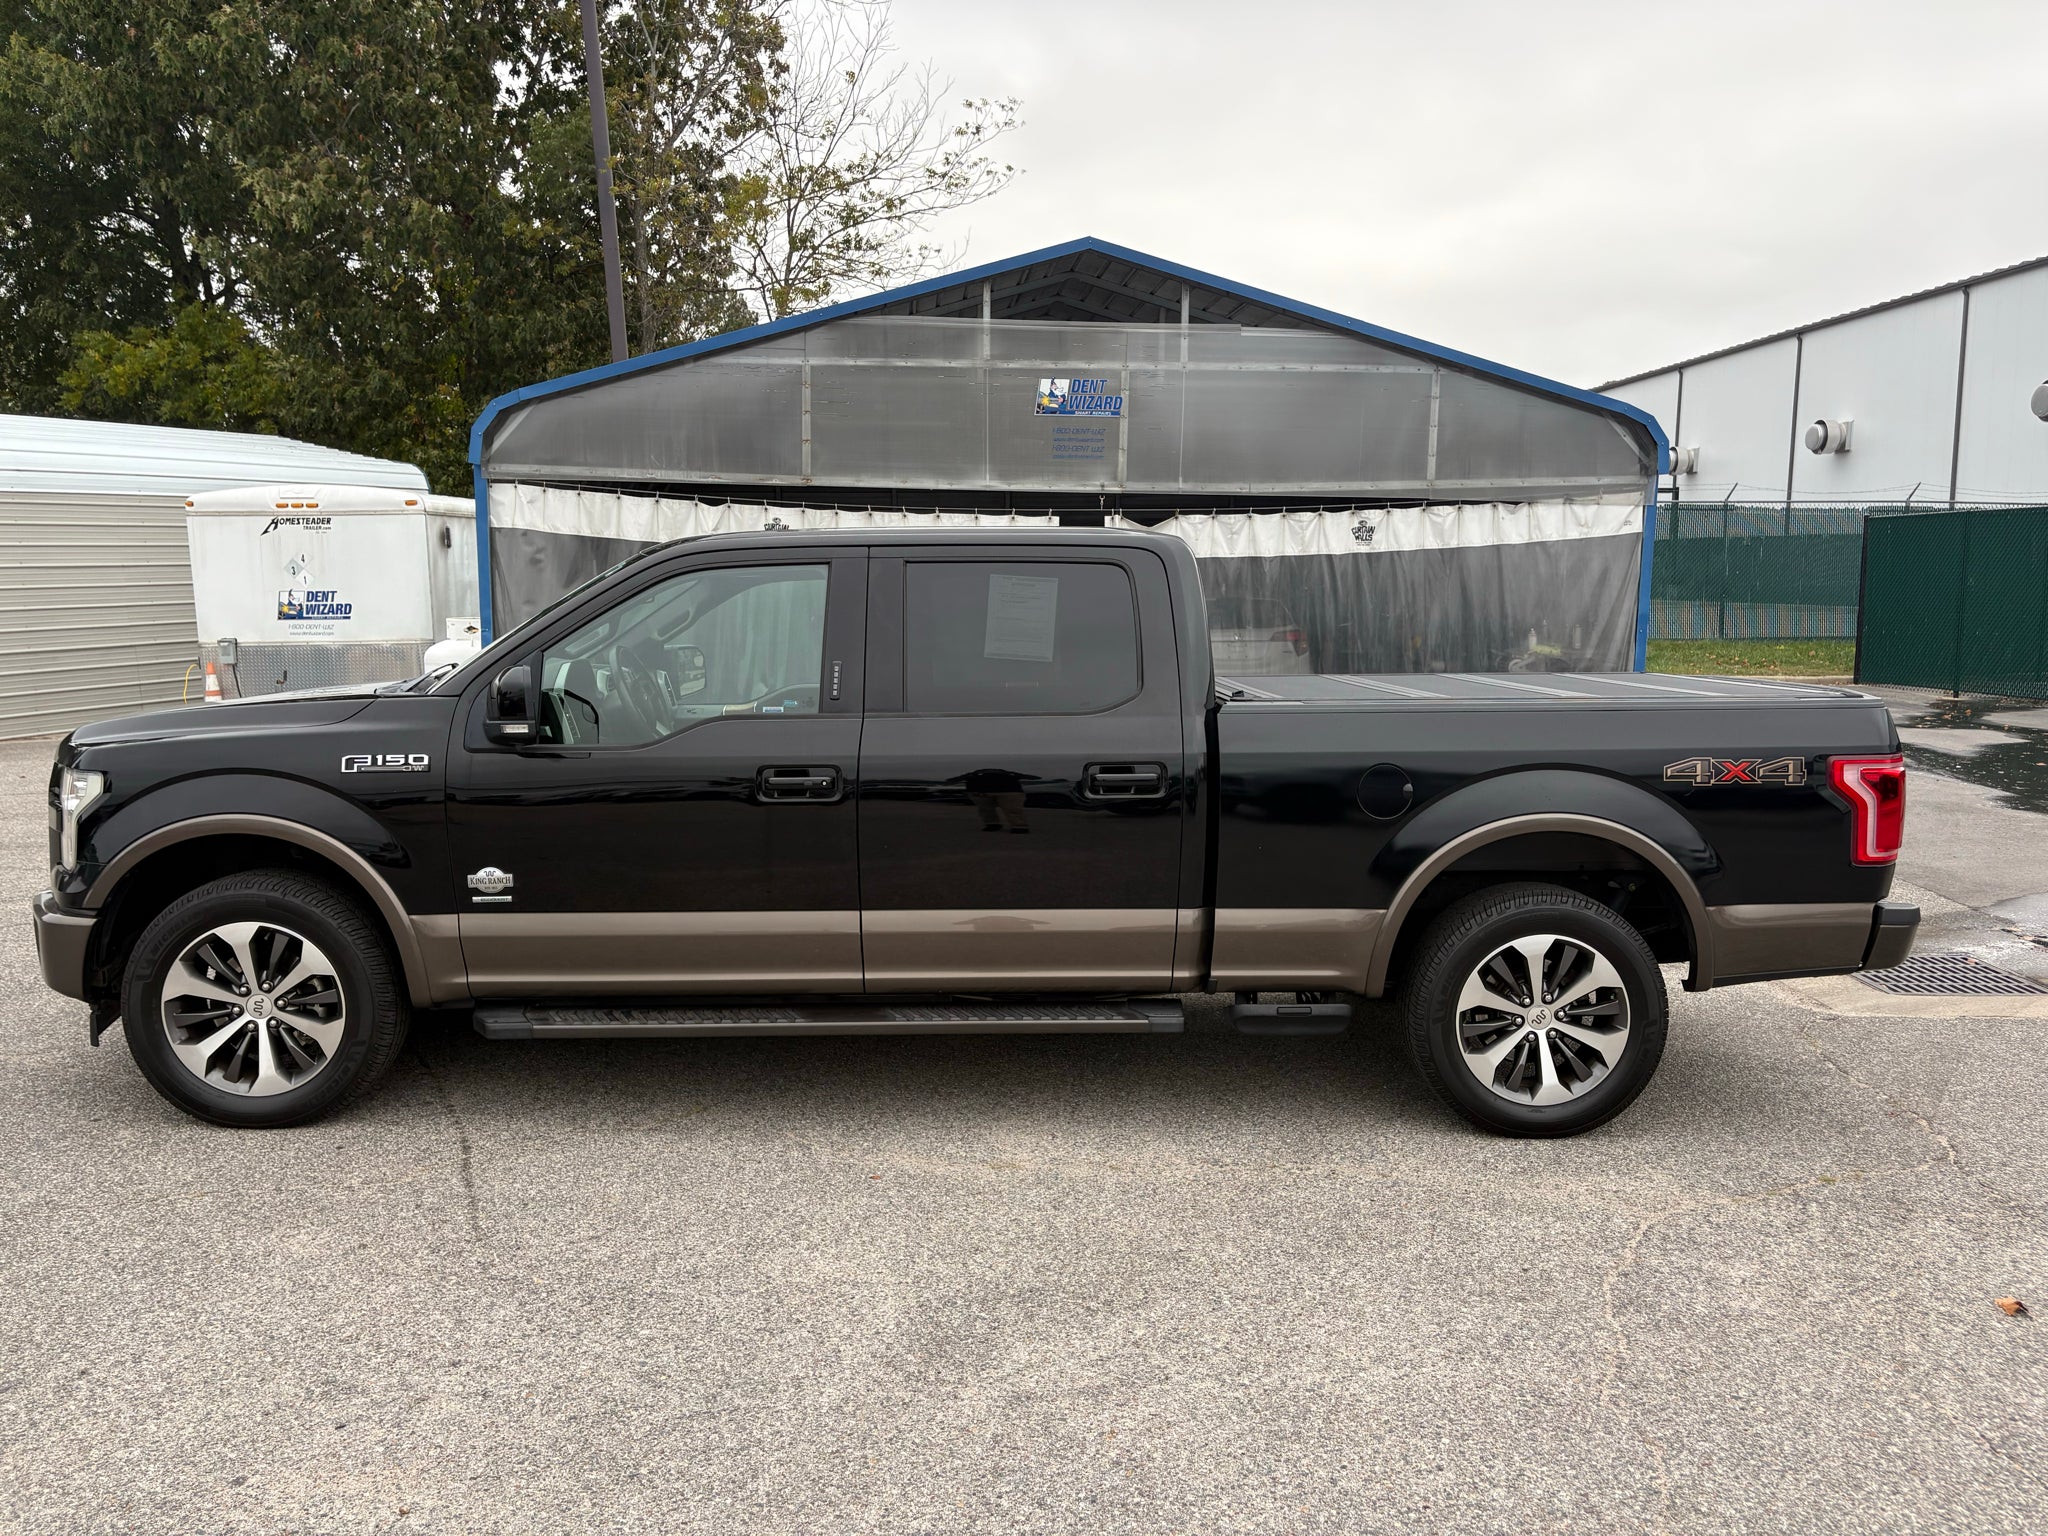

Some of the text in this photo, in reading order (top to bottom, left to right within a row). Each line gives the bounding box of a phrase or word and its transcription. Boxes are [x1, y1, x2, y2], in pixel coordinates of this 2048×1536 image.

[1071, 379, 1107, 394] DENT
[1068, 395, 1123, 410] WIZARD
[260, 516, 332, 536] HOMESTEADER
[291, 566, 296, 576] 3
[306, 591, 337, 602] DENT
[305, 603, 352, 615] WIZARD
[470, 876, 511, 885] KING RANCH
